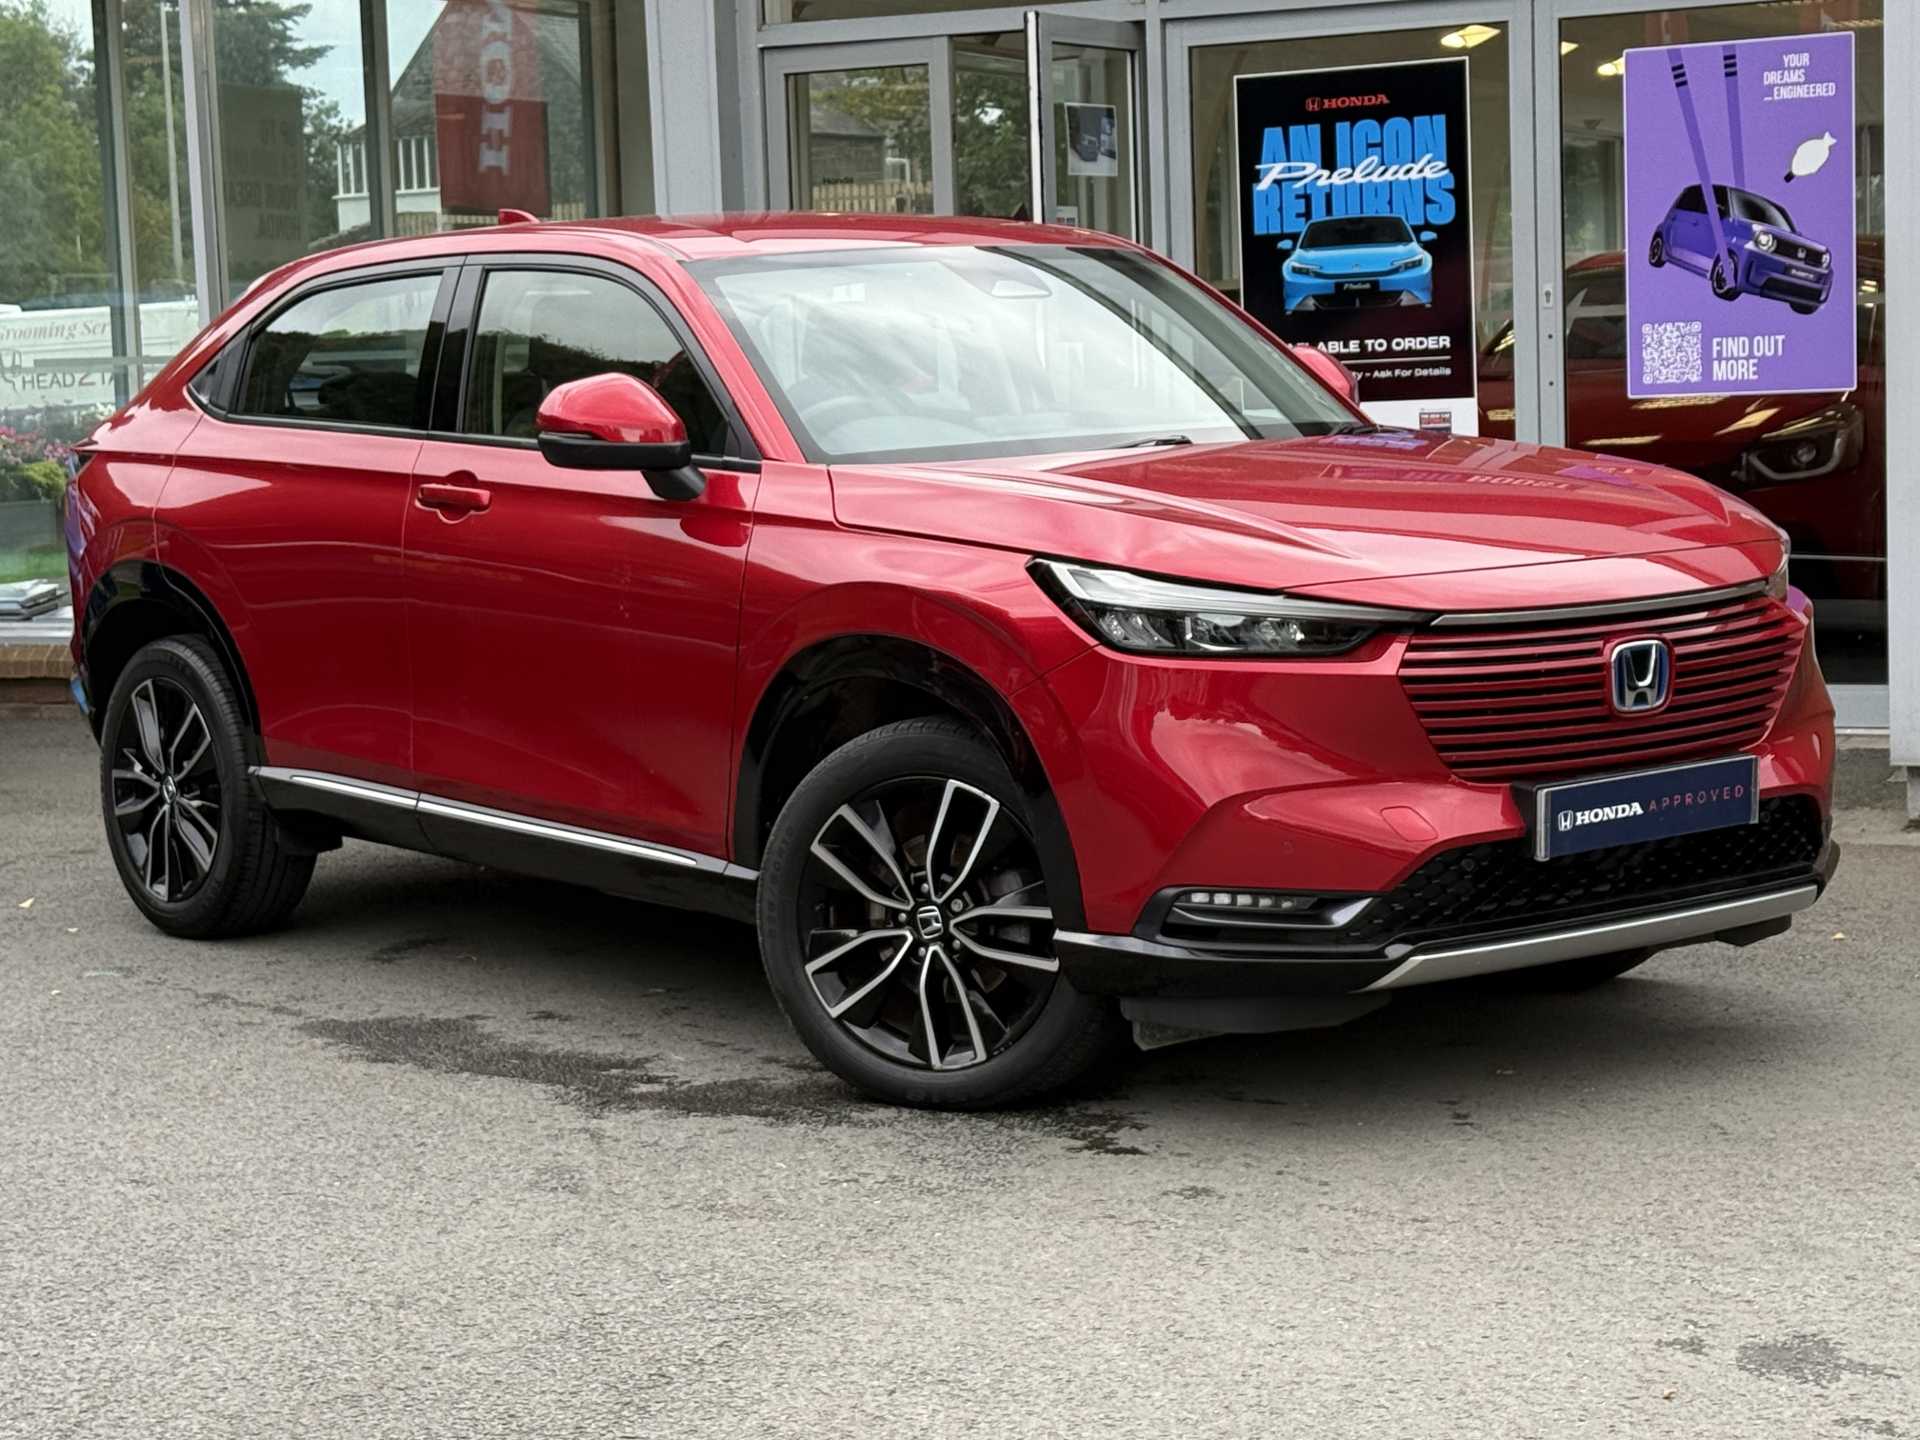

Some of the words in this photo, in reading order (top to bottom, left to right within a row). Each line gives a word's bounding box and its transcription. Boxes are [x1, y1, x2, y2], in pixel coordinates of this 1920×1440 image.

[1782, 52, 1810, 68] YOUR
[1763, 68, 1806, 86] DREAMS
[1322, 94, 1390, 109] HONDA
[1260, 123, 1322, 182] AN
[1335, 114, 1448, 171] ICON
[1254, 152, 1450, 191] Prelude
[1252, 172, 1456, 236] RETURNS
[1364, 338, 1388, 352] TO
[1391, 335, 1451, 351] ORDER
[1712, 336, 1749, 359] FIND
[1753, 334, 1786, 357] OUT
[1372, 369, 1393, 379] Ask
[1394, 368, 1413, 378] For
[1414, 366, 1452, 377] Details
[1712, 358, 1759, 381] MORE
[1575, 802, 1644, 826] HONDA
[1648, 785, 1744, 810] APPROVED
